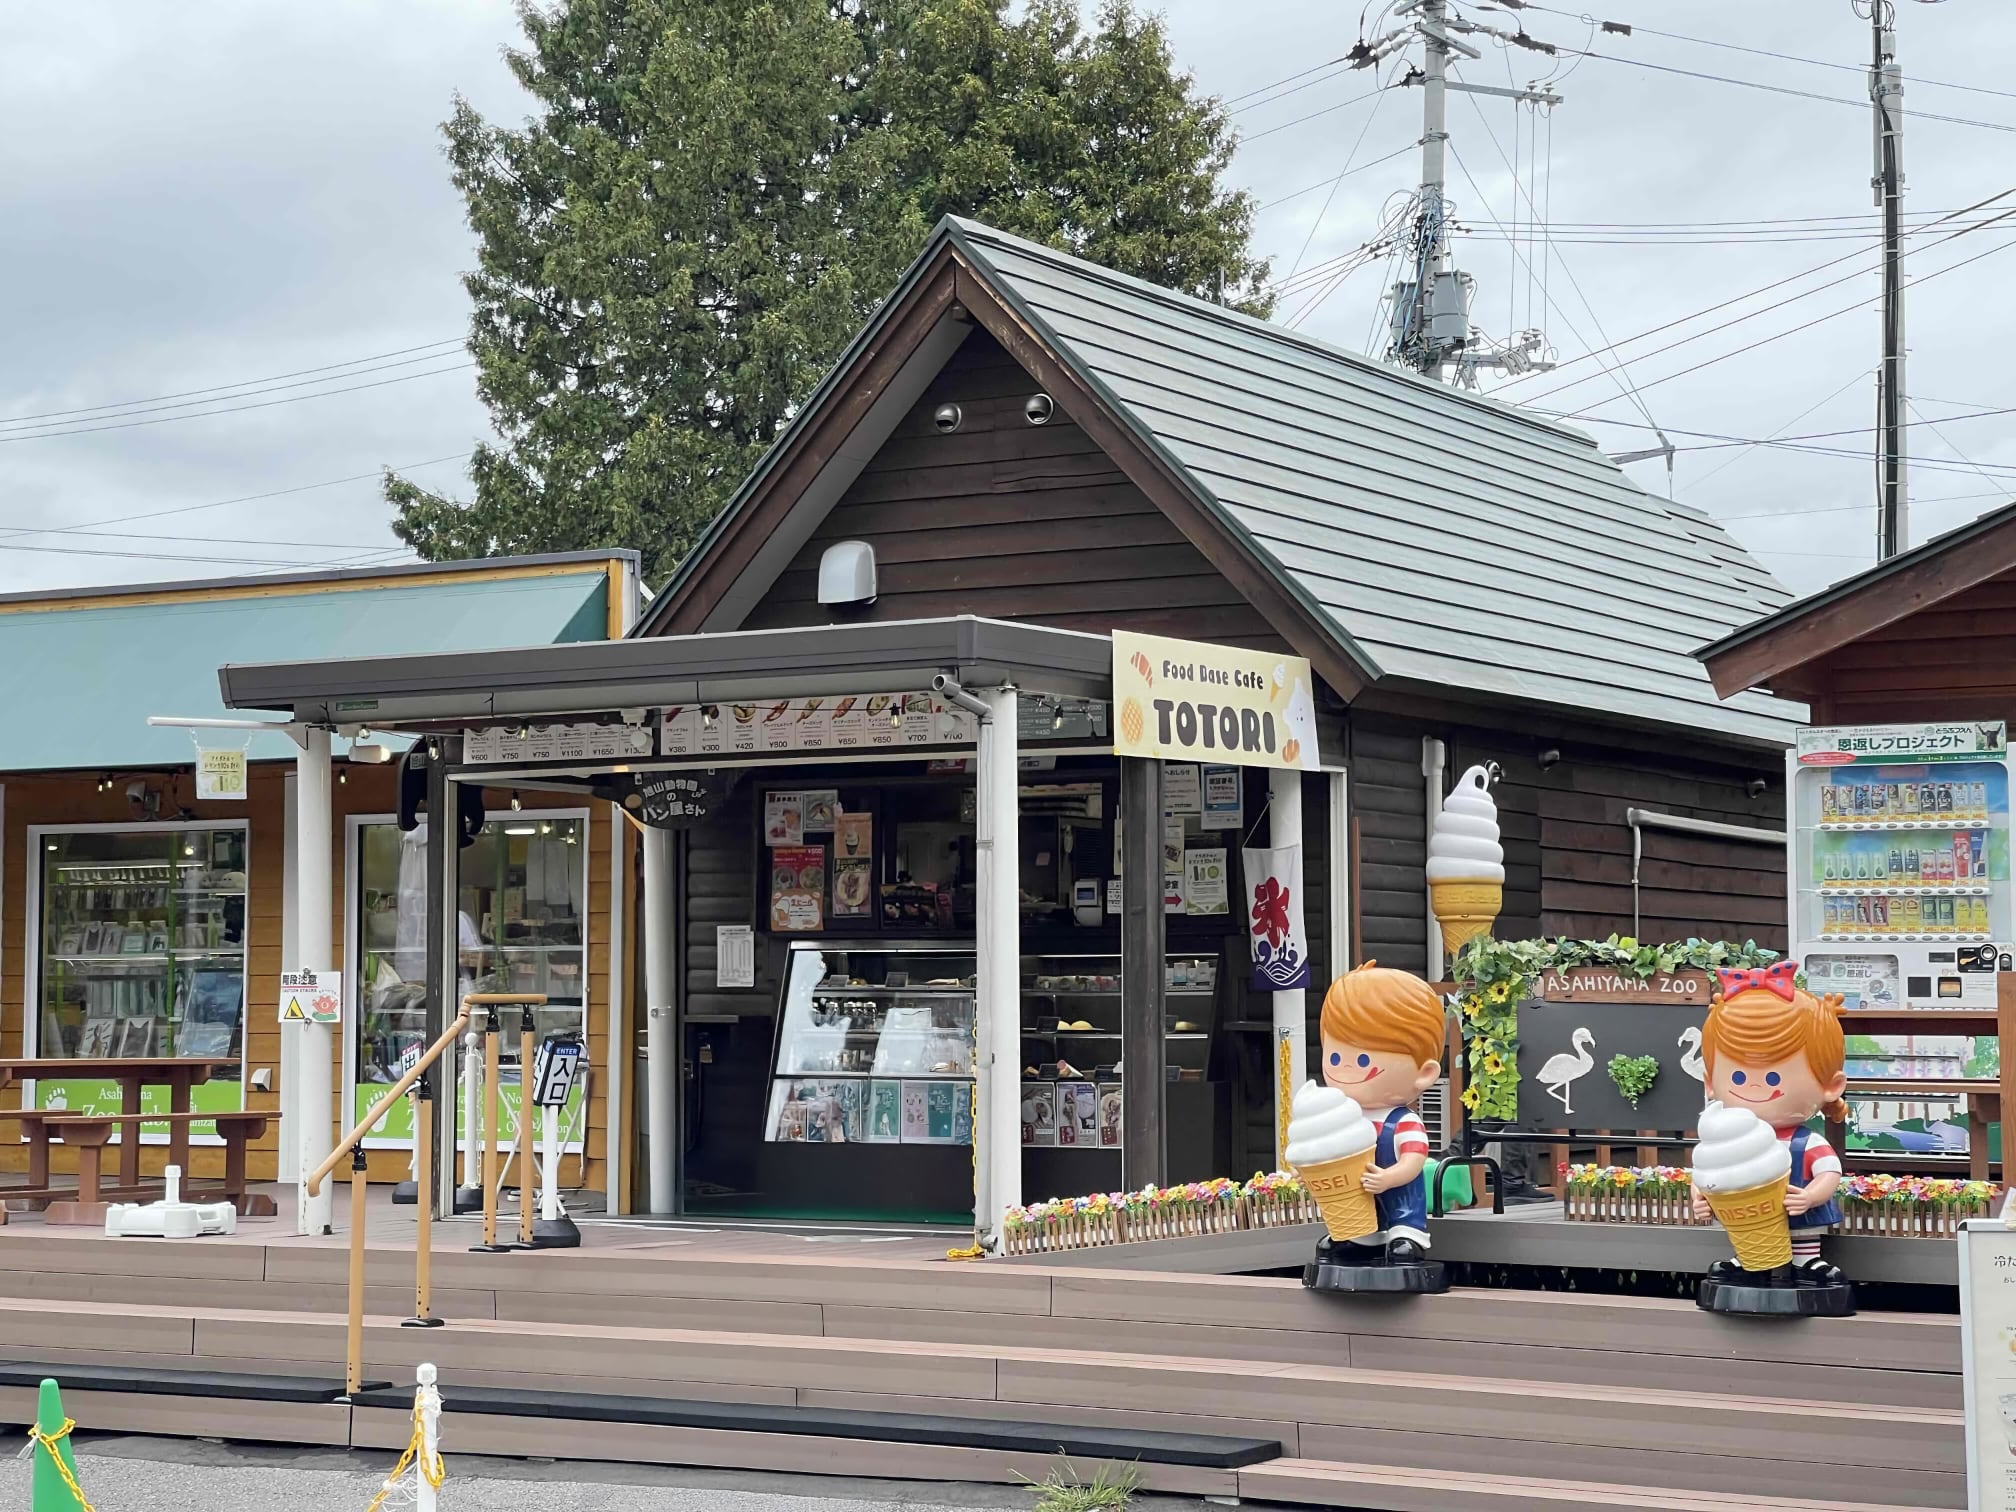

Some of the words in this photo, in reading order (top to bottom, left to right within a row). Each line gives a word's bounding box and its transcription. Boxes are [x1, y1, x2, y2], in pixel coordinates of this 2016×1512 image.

[1163, 660, 1194, 681] Food
[1200, 665, 1229, 686] Base
[1234, 669, 1264, 690] Cafe
[1153, 699, 1276, 754] TOTORI
[735, 742, 754, 750] ¥420
[1838, 734, 1965, 751] 恩返しプロジェクト
[501, 752, 519, 760] ¥750
[561, 749, 583, 757] ¥1100
[592, 748, 615, 756] ¥1650
[666, 792, 676, 801] の
[642, 801, 706, 821] パン屋さん
[283, 974, 317, 985] 階段注意
[1547, 974, 1650, 993] ASAHIYAMA
[1659, 976, 1697, 994] ZOO
[556, 1047, 578, 1055] ENTER
[550, 1057, 570, 1101] 入口
[1718, 1199, 1776, 1222] NISSEI
